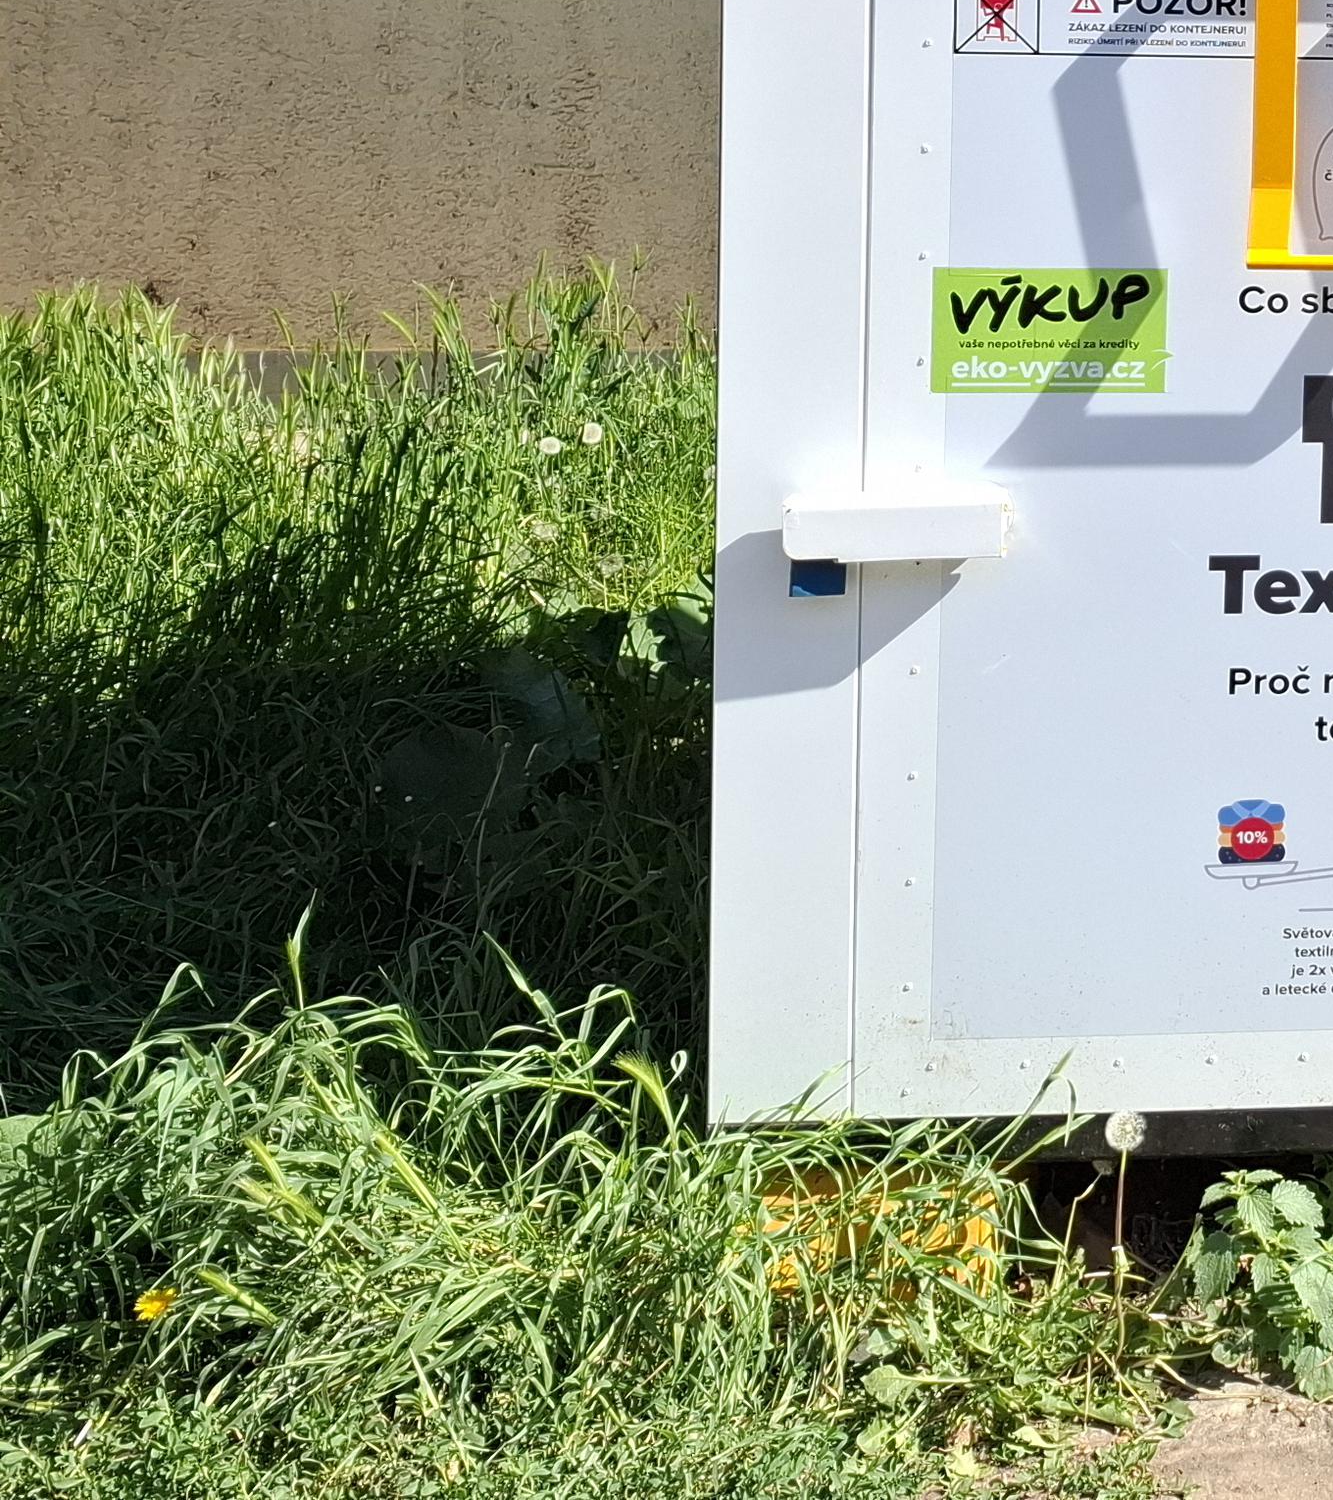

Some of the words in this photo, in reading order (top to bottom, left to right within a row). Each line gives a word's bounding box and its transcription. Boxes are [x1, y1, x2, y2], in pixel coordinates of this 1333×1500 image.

[1068, 21, 1105, 32] ZÁKAZ
[1109, 22, 1147, 33] LEZENÍ
[1150, 25, 1166, 33] DO
[1170, 25, 1247, 35] KONTEJNERU!
[950, 273, 1150, 333] VÝKUP
[1239, 284, 1290, 314] Co
[959, 339, 985, 349] vaše
[987, 338, 1055, 353] nepotřebné
[1057, 338, 1081, 350] věci
[1084, 340, 1095, 350] za
[1098, 338, 1140, 352] kredity
[952, 355, 1145, 383] eko-vyzva.cz
[1228, 665, 1310, 696] Proč
[1236, 830, 1268, 846] 10%
[1290, 962, 1304, 978] je
[1309, 963, 1326, 975] 2x
[1262, 986, 1270, 995] a
[1274, 981, 1326, 995] letecké
